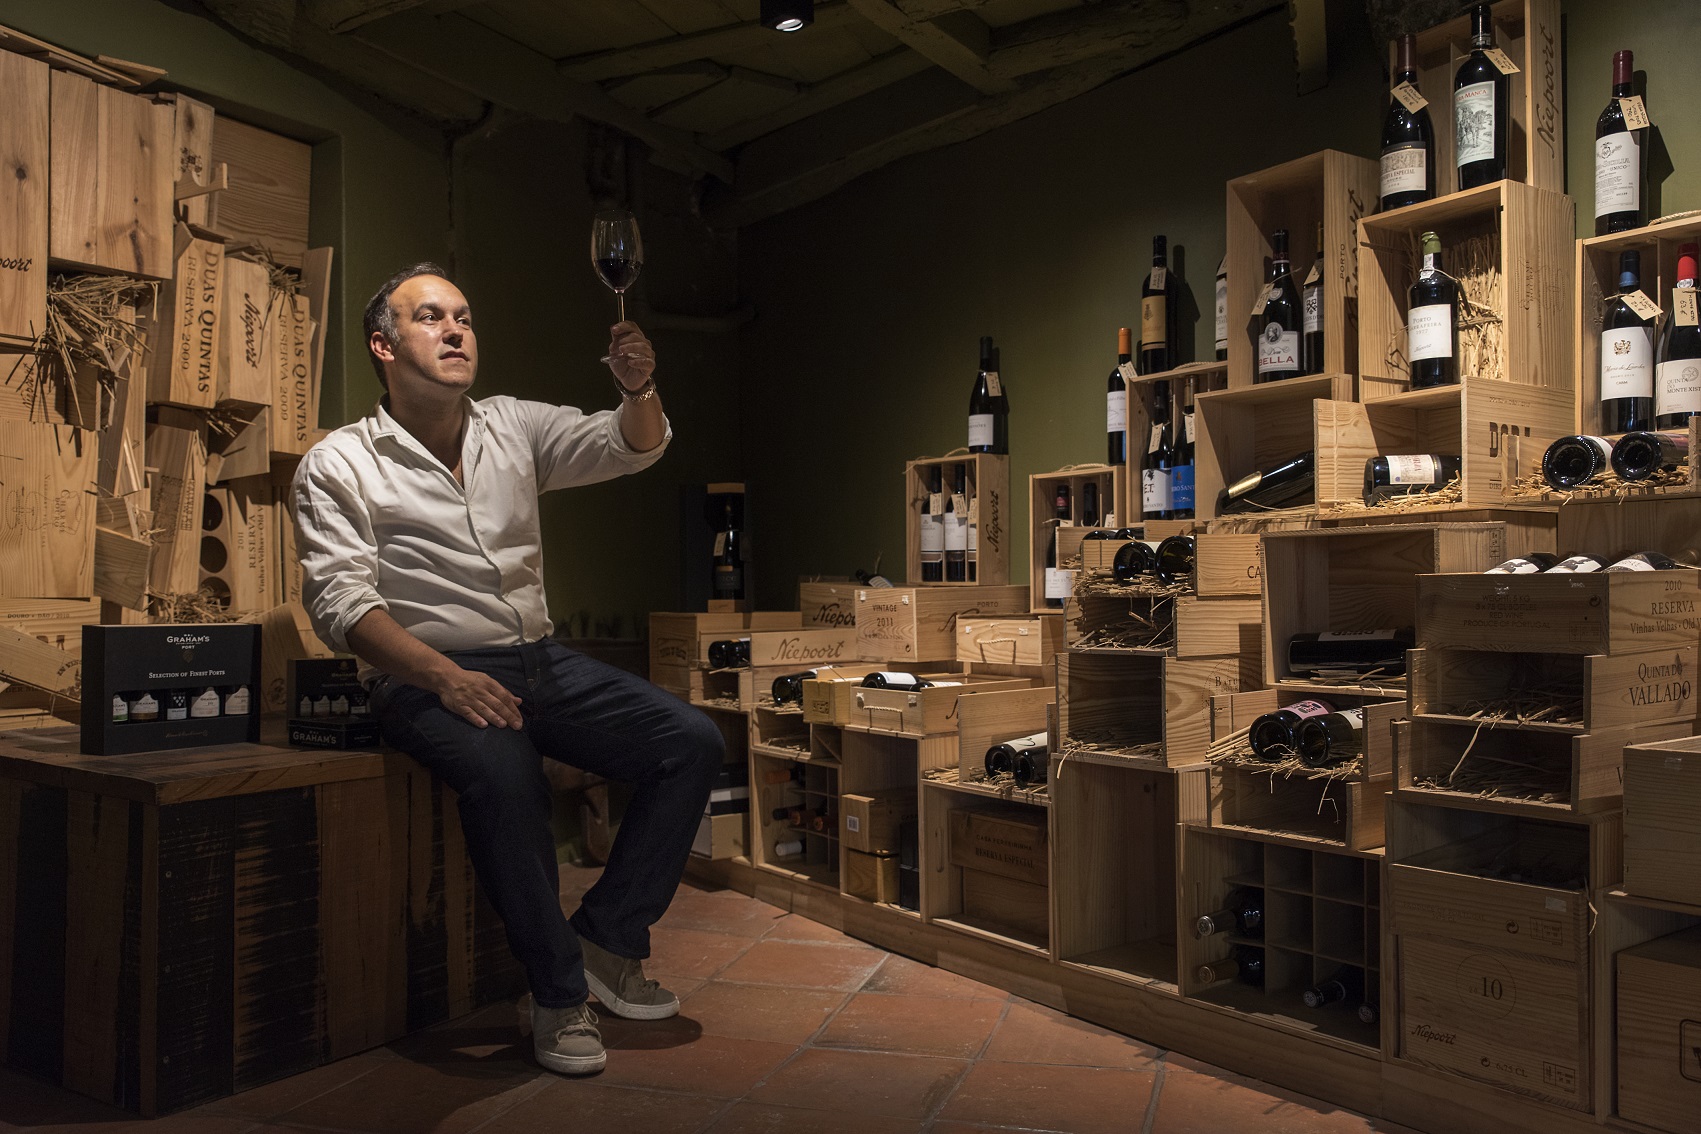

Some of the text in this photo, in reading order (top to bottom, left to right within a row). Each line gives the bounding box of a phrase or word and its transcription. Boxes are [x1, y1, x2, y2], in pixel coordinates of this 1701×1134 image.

[1537, 23, 1559, 160] Niepoort
[181, 256, 197, 371] RESERVA 2009
[198, 250, 219, 393] DUAS QUINTAS
[1412, 316, 1432, 324] PORTO
[239, 292, 263, 370] Niepoort
[278, 313, 289, 421] RESERVA 2009
[1258, 355, 1295, 367] BELLA
[292, 308, 308, 442] DUAS QUINTAS
[1667, 386, 1688, 394] MONTE
[257, 514, 265, 530] Old
[985, 489, 1003, 552] Niepoort
[248, 515, 257, 569] RESERVA
[1664, 580, 1682, 591] 2010
[872, 604, 897, 613] VINTAGE
[1508, 603, 1537, 611] BOTTLES
[1651, 600, 1695, 615] RESERVA
[876, 617, 894, 628] 2011
[1463, 619, 1498, 627] PRODUCE
[1511, 620, 1551, 629] PORTUGAL
[1505, 612, 1524, 620] WINE
[1630, 621, 1655, 634] Vinhas
[1656, 618, 1678, 632] Velhas
[1682, 617, 1695, 630] Old
[166, 635, 210, 643] GRAHAM'S
[771, 637, 845, 661] Niepoort
[148, 671, 179, 679] SELECTION
[1638, 662, 1683, 683] QUINTA DO
[1628, 680, 1692, 707] VALLADO
[293, 731, 337, 744] GRAHAM'S
[976, 834, 1032, 851] CASA FERREIRINHA
[975, 847, 1034, 869] RESERVA ESPECIAL
[1411, 1024, 1457, 1046] Niepoort
[1515, 1067, 1528, 1078] CL
